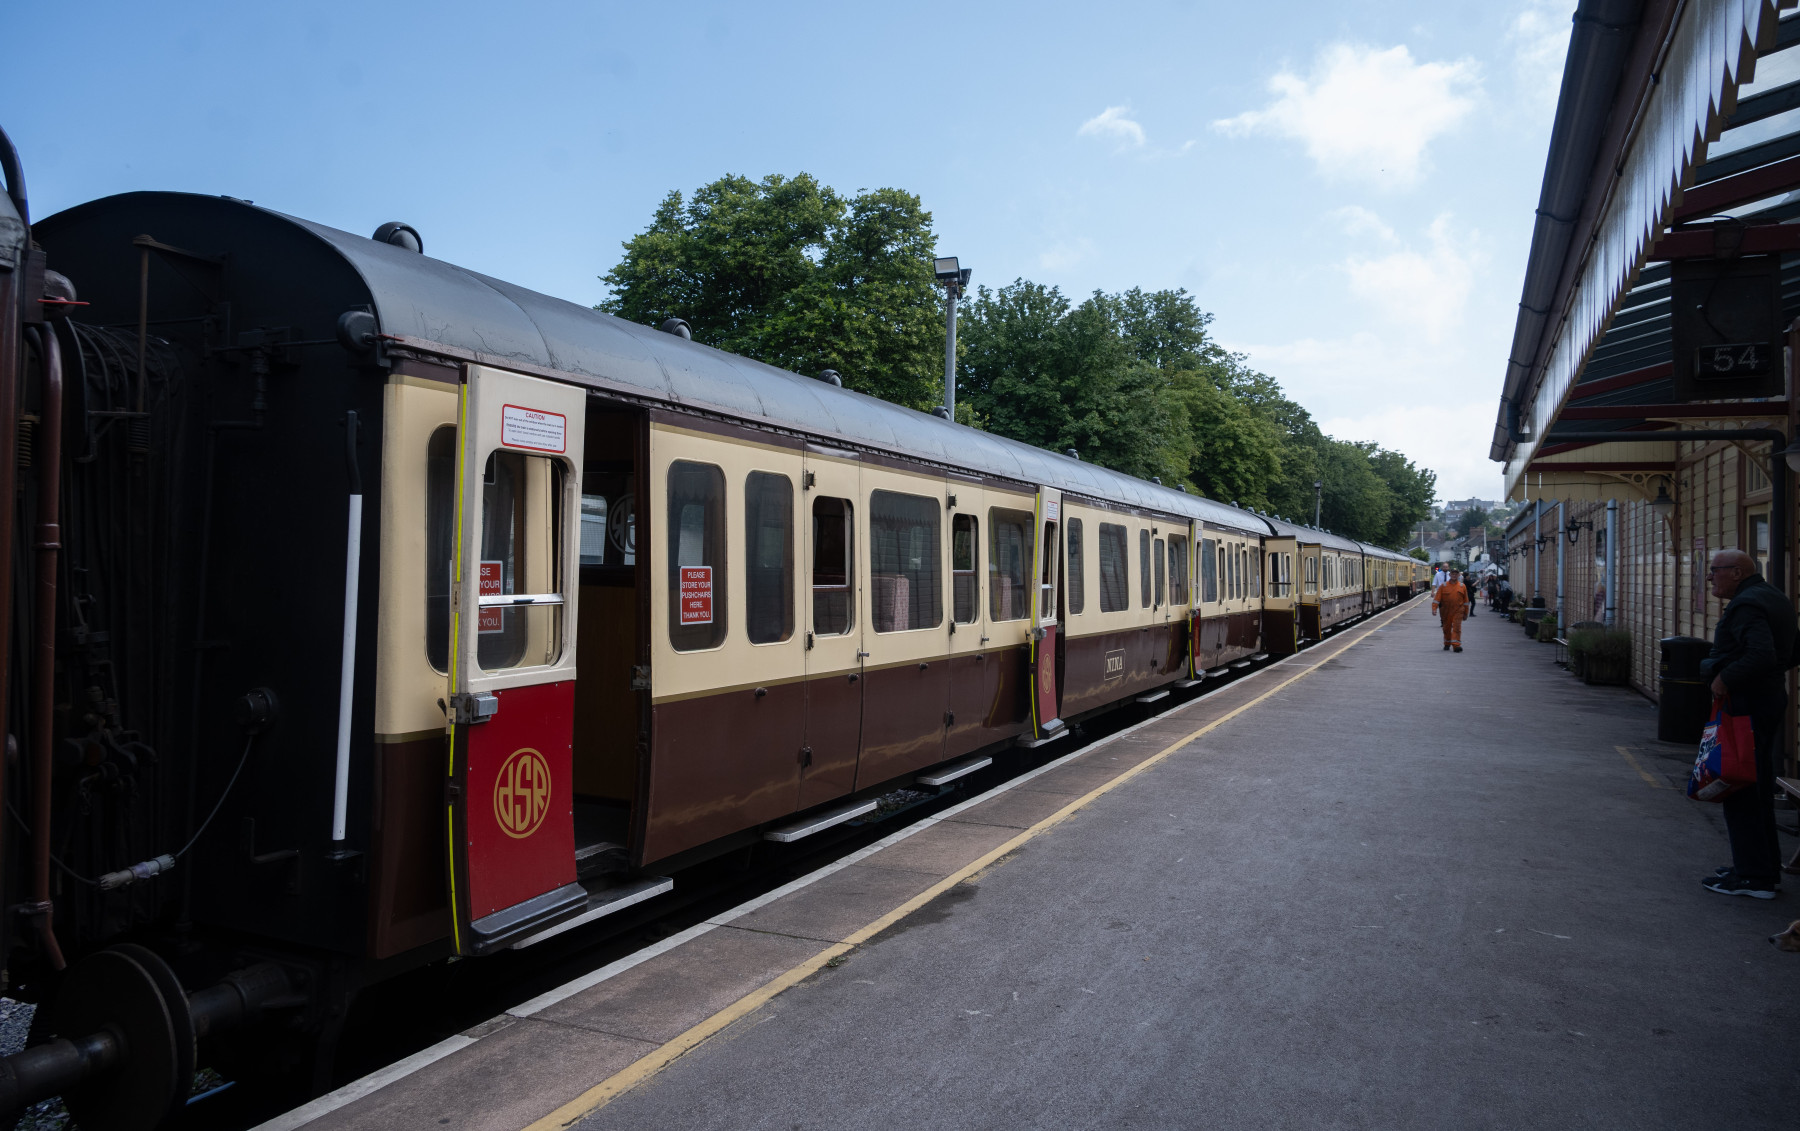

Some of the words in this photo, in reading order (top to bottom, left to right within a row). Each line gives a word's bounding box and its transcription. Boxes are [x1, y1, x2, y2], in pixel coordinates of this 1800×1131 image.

[1713, 345, 1760, 372] 54
[525, 412, 545, 420] CAUTION
[687, 571, 706, 579] PLEASE
[480, 580, 500, 589] YOUR
[682, 581, 698, 589] STORE
[698, 581, 711, 589] YOUR
[681, 591, 711, 599] PUSHCHAIRS
[683, 611, 700, 619] THANK
[482, 617, 500, 627] YOU.
